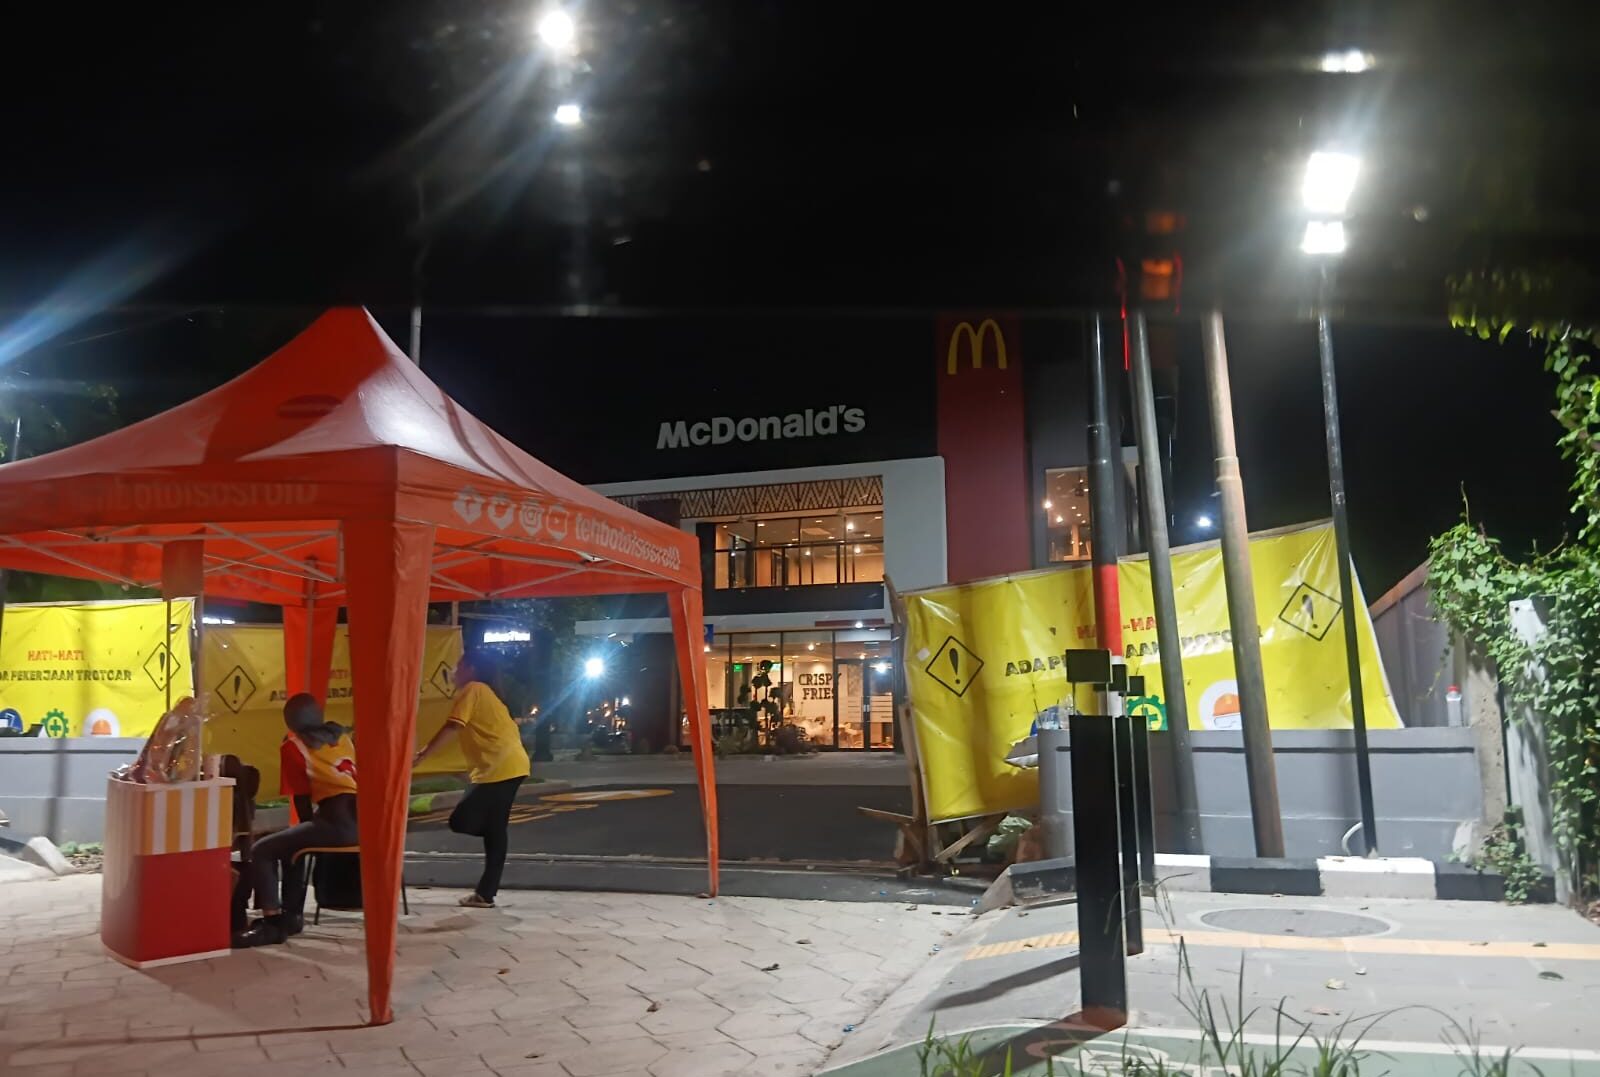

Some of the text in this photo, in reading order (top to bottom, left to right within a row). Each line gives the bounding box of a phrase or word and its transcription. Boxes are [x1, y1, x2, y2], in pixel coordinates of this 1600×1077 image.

[656, 405, 866, 450] McDonald's
[28, 650, 84, 661] HATI-HATI
[1005, 657, 1046, 677] ADA
